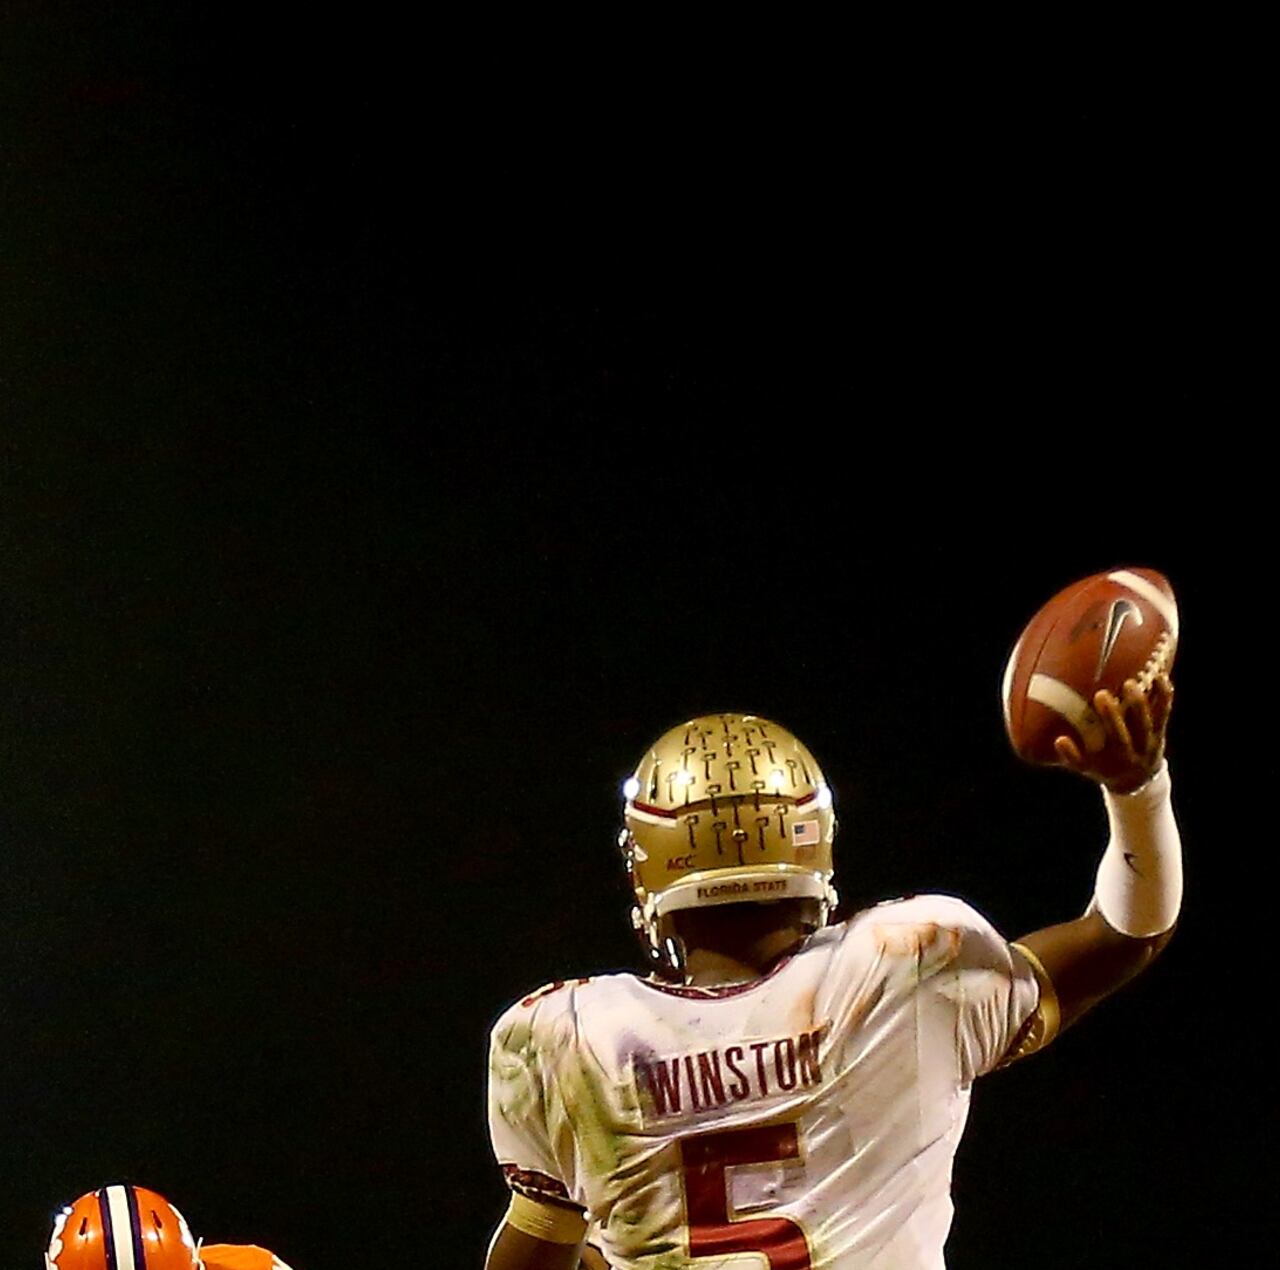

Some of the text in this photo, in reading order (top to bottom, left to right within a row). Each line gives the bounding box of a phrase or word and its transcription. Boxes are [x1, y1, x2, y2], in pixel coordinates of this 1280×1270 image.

[665, 854, 697, 871] ACC
[697, 880, 788, 898] FLORIDA STATE
[648, 1029, 824, 1115] WINSTON
